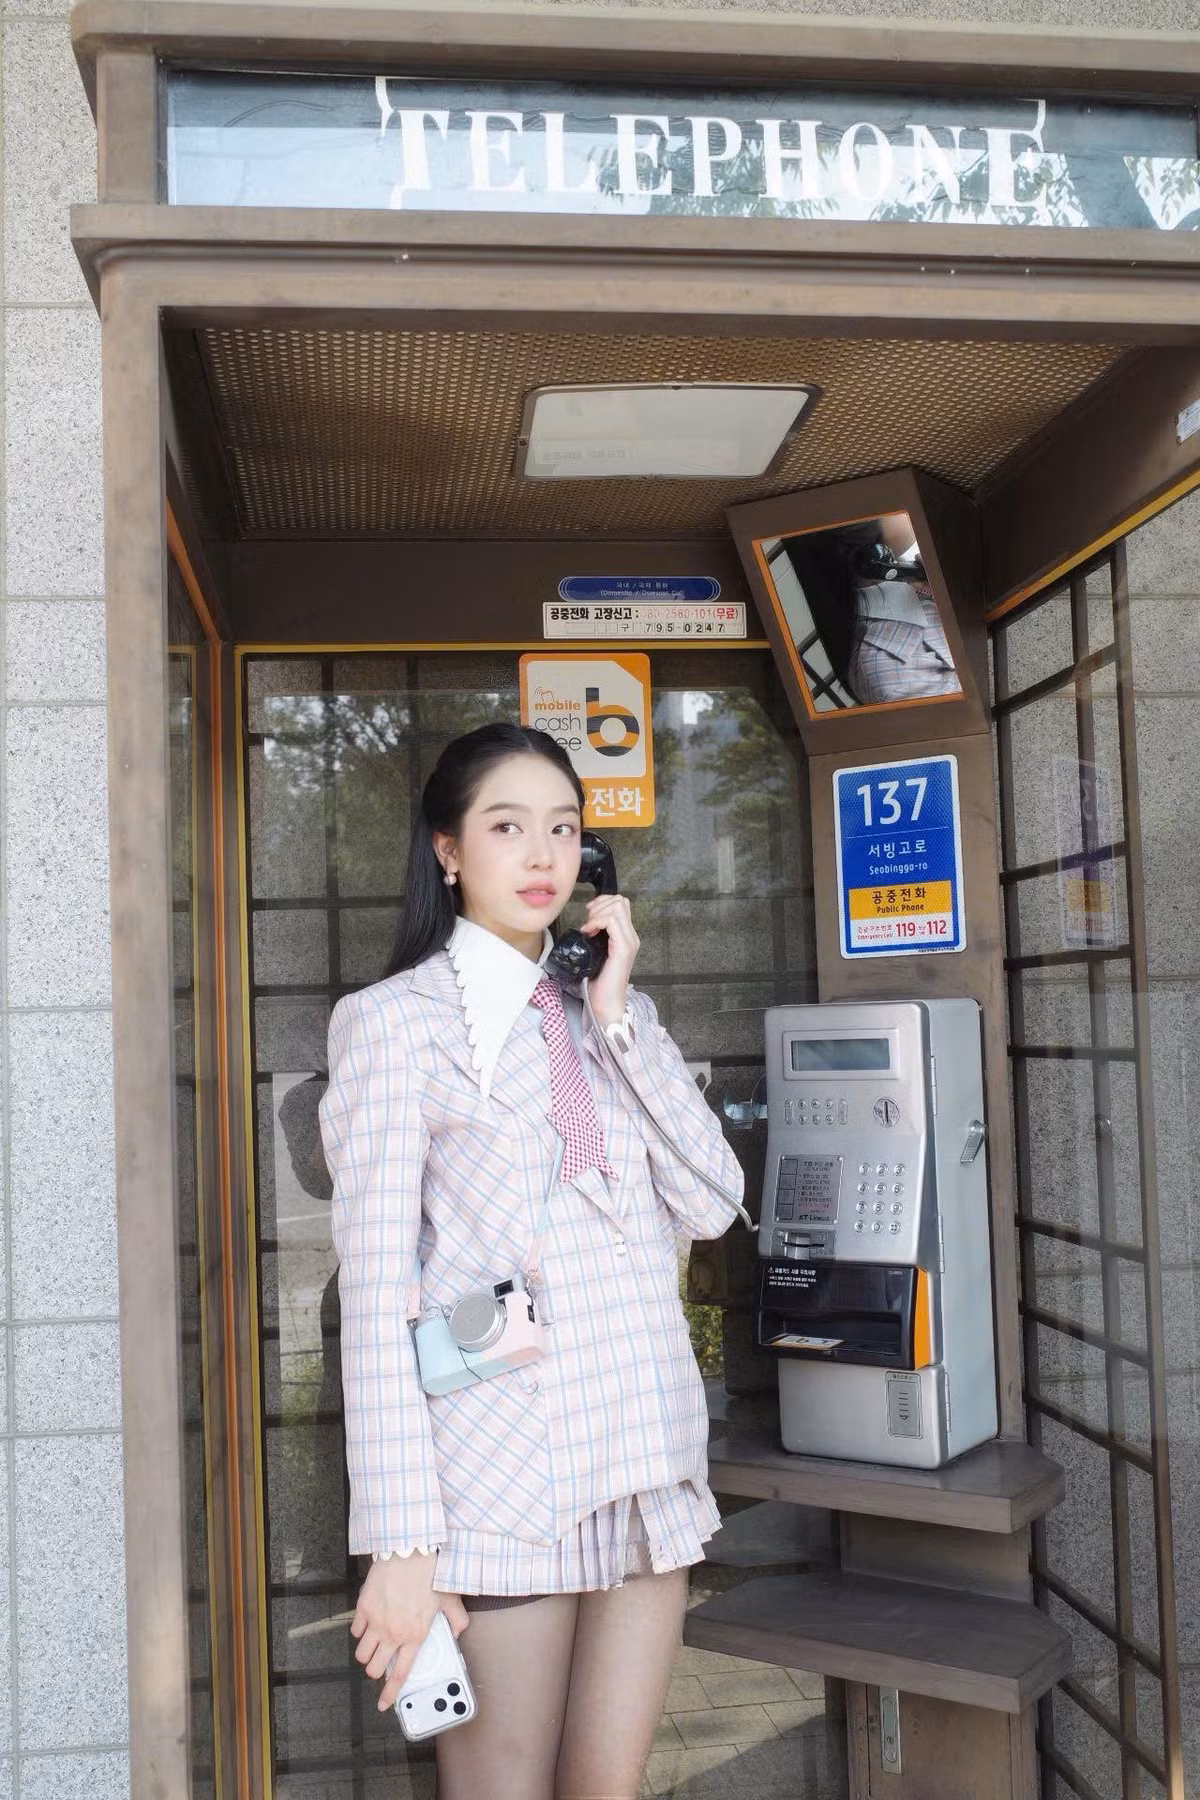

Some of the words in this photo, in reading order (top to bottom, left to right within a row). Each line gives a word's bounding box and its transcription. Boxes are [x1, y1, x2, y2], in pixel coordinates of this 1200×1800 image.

[379, 106, 1046, 208] TELEPHONE
[550, 607, 589, 620] 공중전화
[534, 700, 581, 711] mobile
[534, 713, 581, 732] cash
[555, 737, 582, 751] ee
[586, 787, 644, 817] 전화
[857, 777, 928, 827] 137
[868, 840, 928, 859] 서빙고로
[869, 862, 928, 875] Seobinggo-ro
[872, 887, 927, 905] 공중전화
[877, 905, 899, 914] Public
[901, 903, 925, 912] Phone
[896, 922, 916, 937] 119
[926, 919, 947, 936] 112
